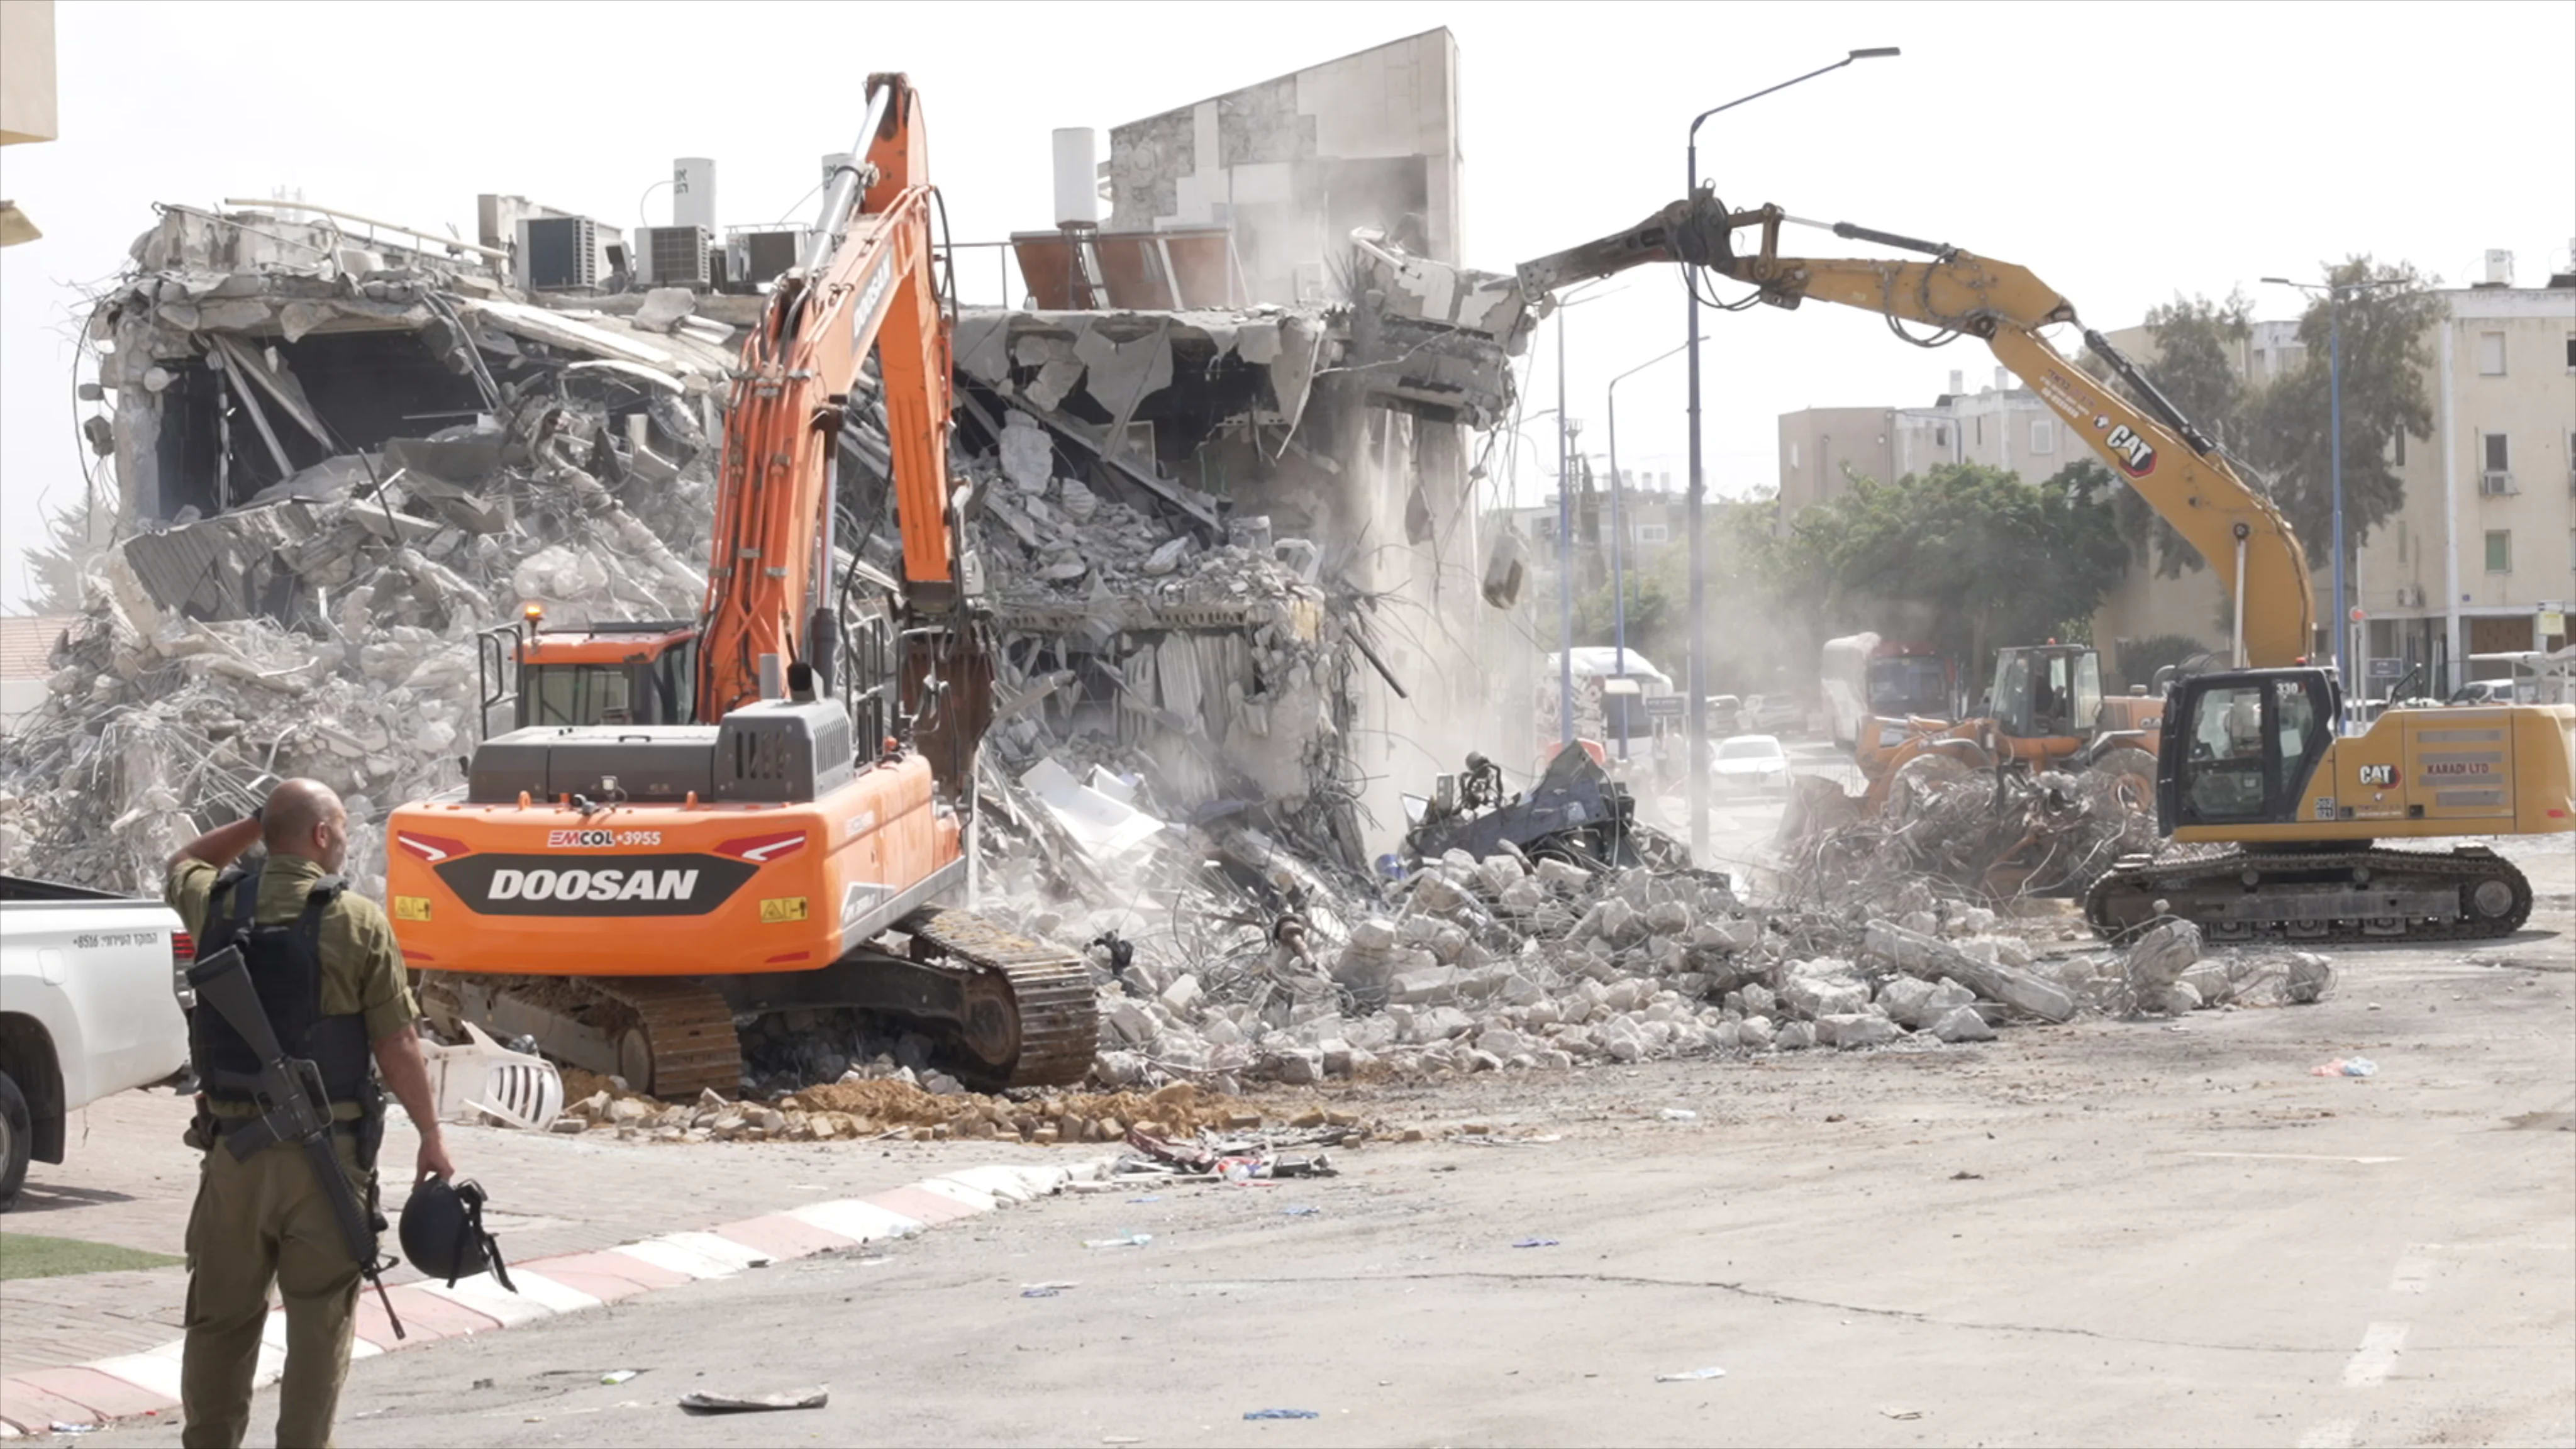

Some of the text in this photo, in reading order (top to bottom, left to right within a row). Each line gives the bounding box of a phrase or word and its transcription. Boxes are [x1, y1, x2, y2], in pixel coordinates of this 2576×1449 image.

[2107, 425, 2153, 467] CAT
[2276, 682, 2298, 695] 330
[2360, 765, 2392, 785] CAT
[2468, 762, 2490, 774] LTD
[550, 831, 614, 846] EMCOL
[487, 869, 699, 901] DOOSAN
